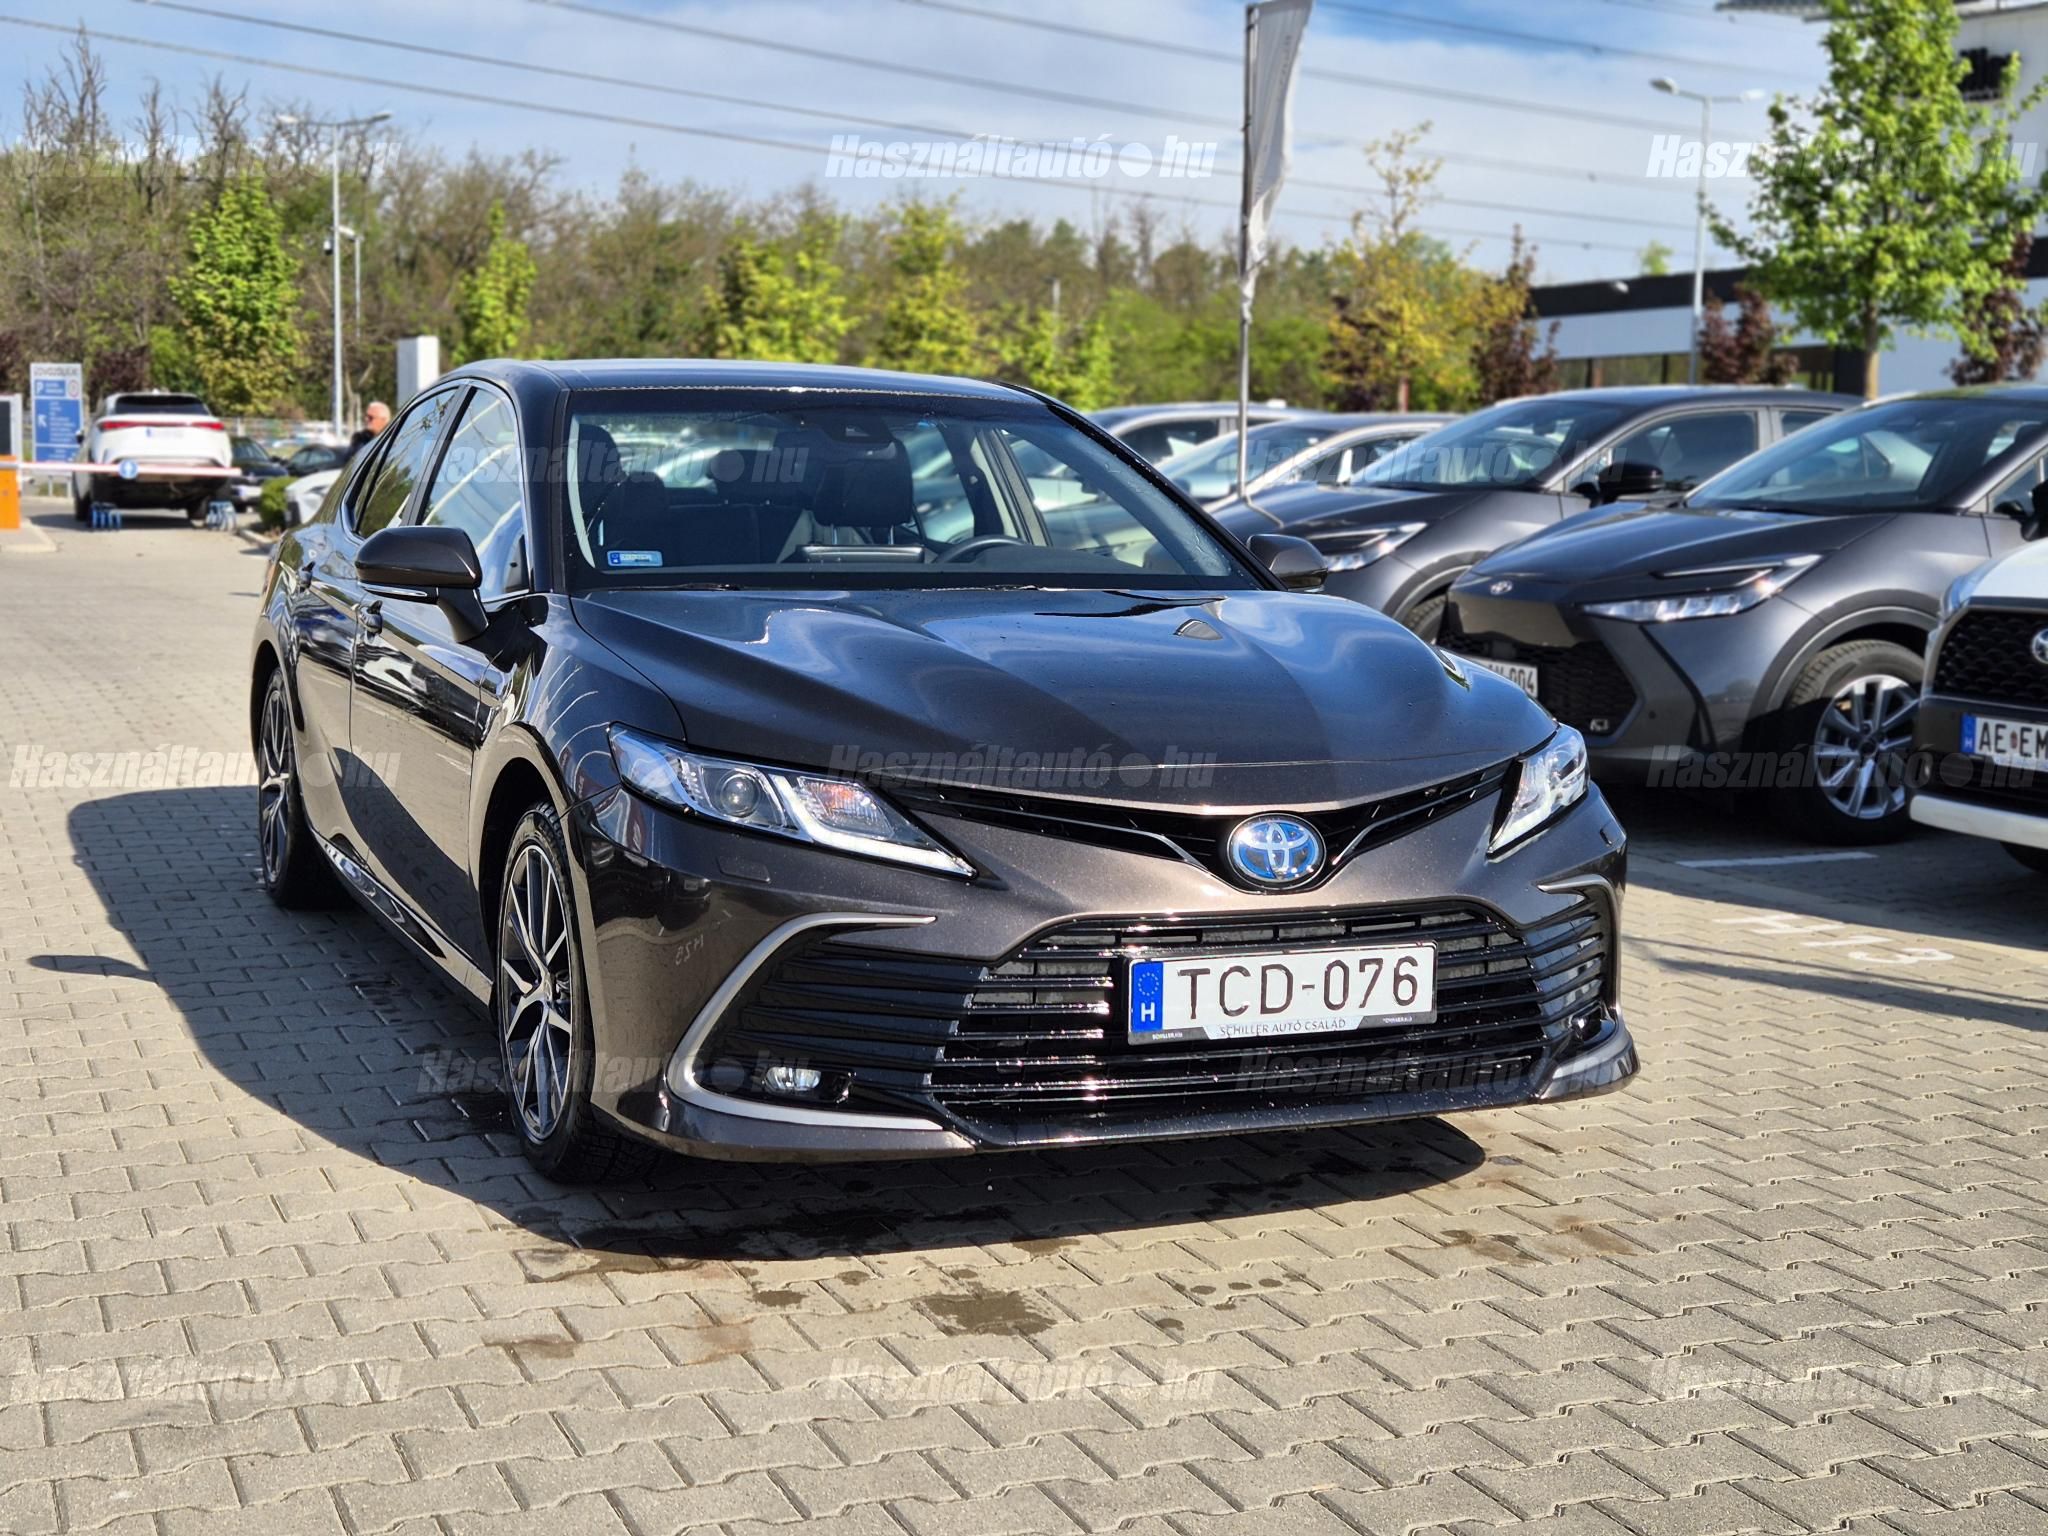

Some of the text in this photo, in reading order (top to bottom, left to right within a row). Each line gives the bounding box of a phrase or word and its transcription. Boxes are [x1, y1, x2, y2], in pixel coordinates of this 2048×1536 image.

[1140, 954, 1420, 1023] H TCD-076
[1219, 1023, 1270, 1037] SCHILLER
